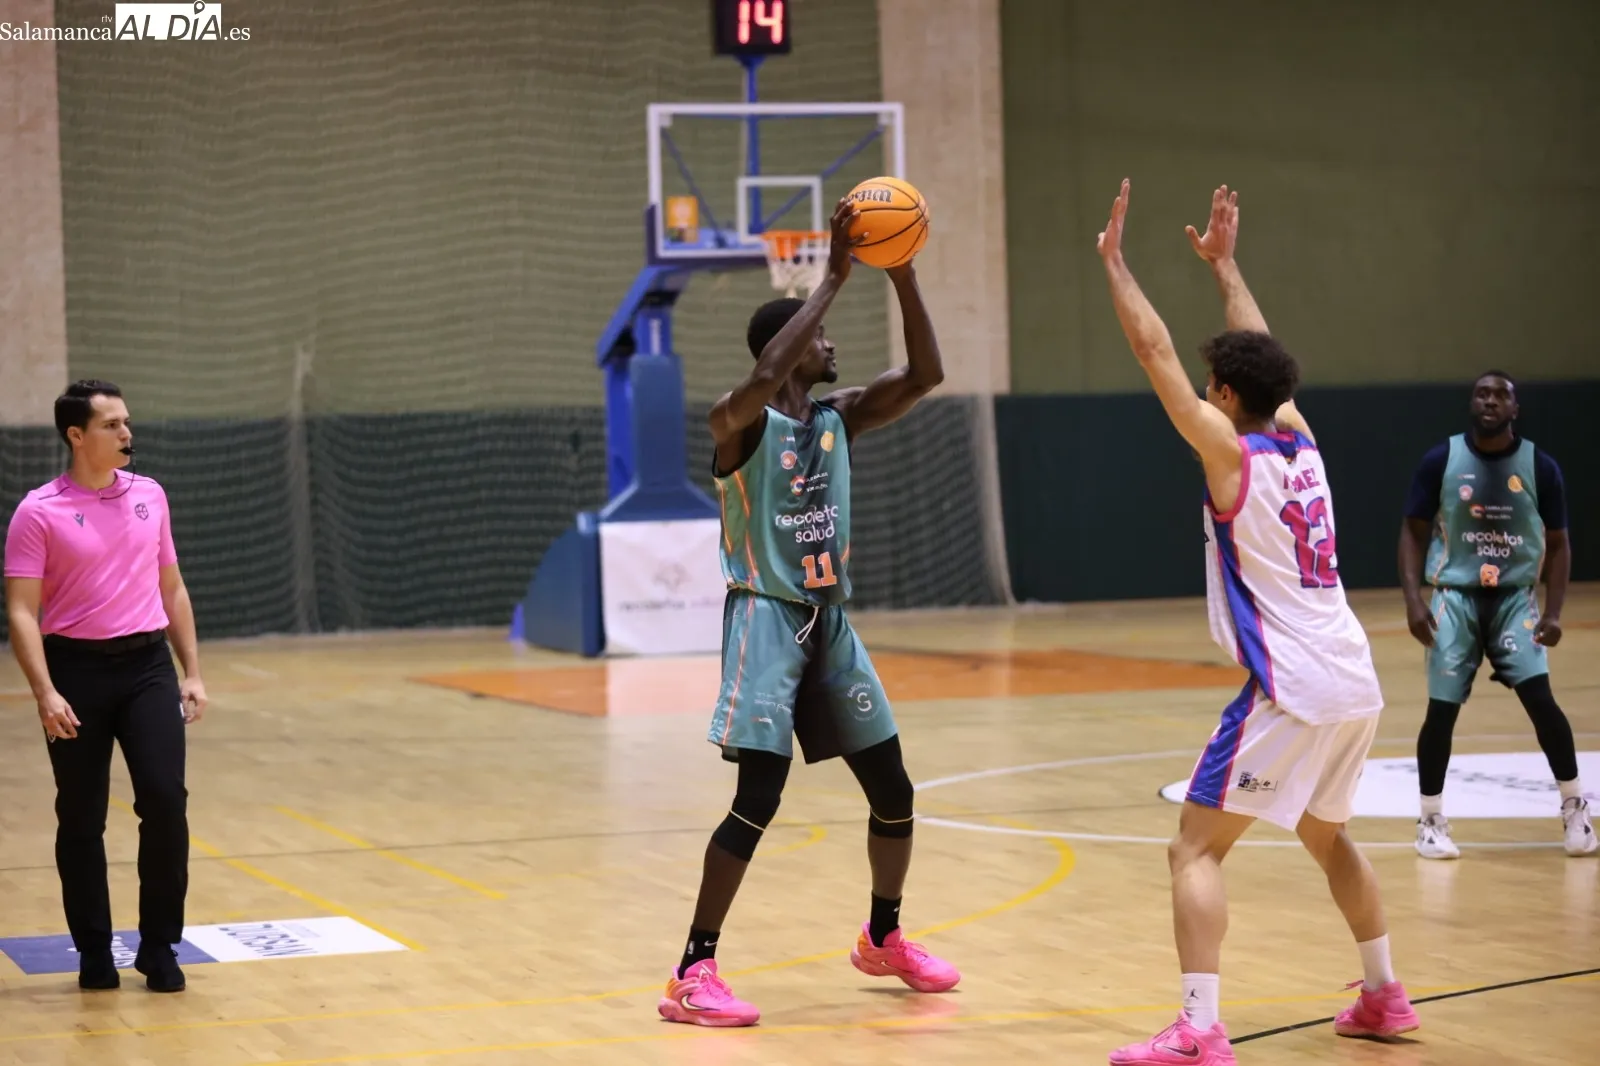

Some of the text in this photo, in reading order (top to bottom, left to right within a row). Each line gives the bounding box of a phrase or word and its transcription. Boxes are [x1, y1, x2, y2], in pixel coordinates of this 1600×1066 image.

[737, 0, 784, 44] 14
[775, 504, 839, 526] recolet
[795, 520, 835, 543] salud
[1279, 496, 1338, 588] 12
[1476, 543, 1511, 559] salud
[802, 551, 837, 589] 11
